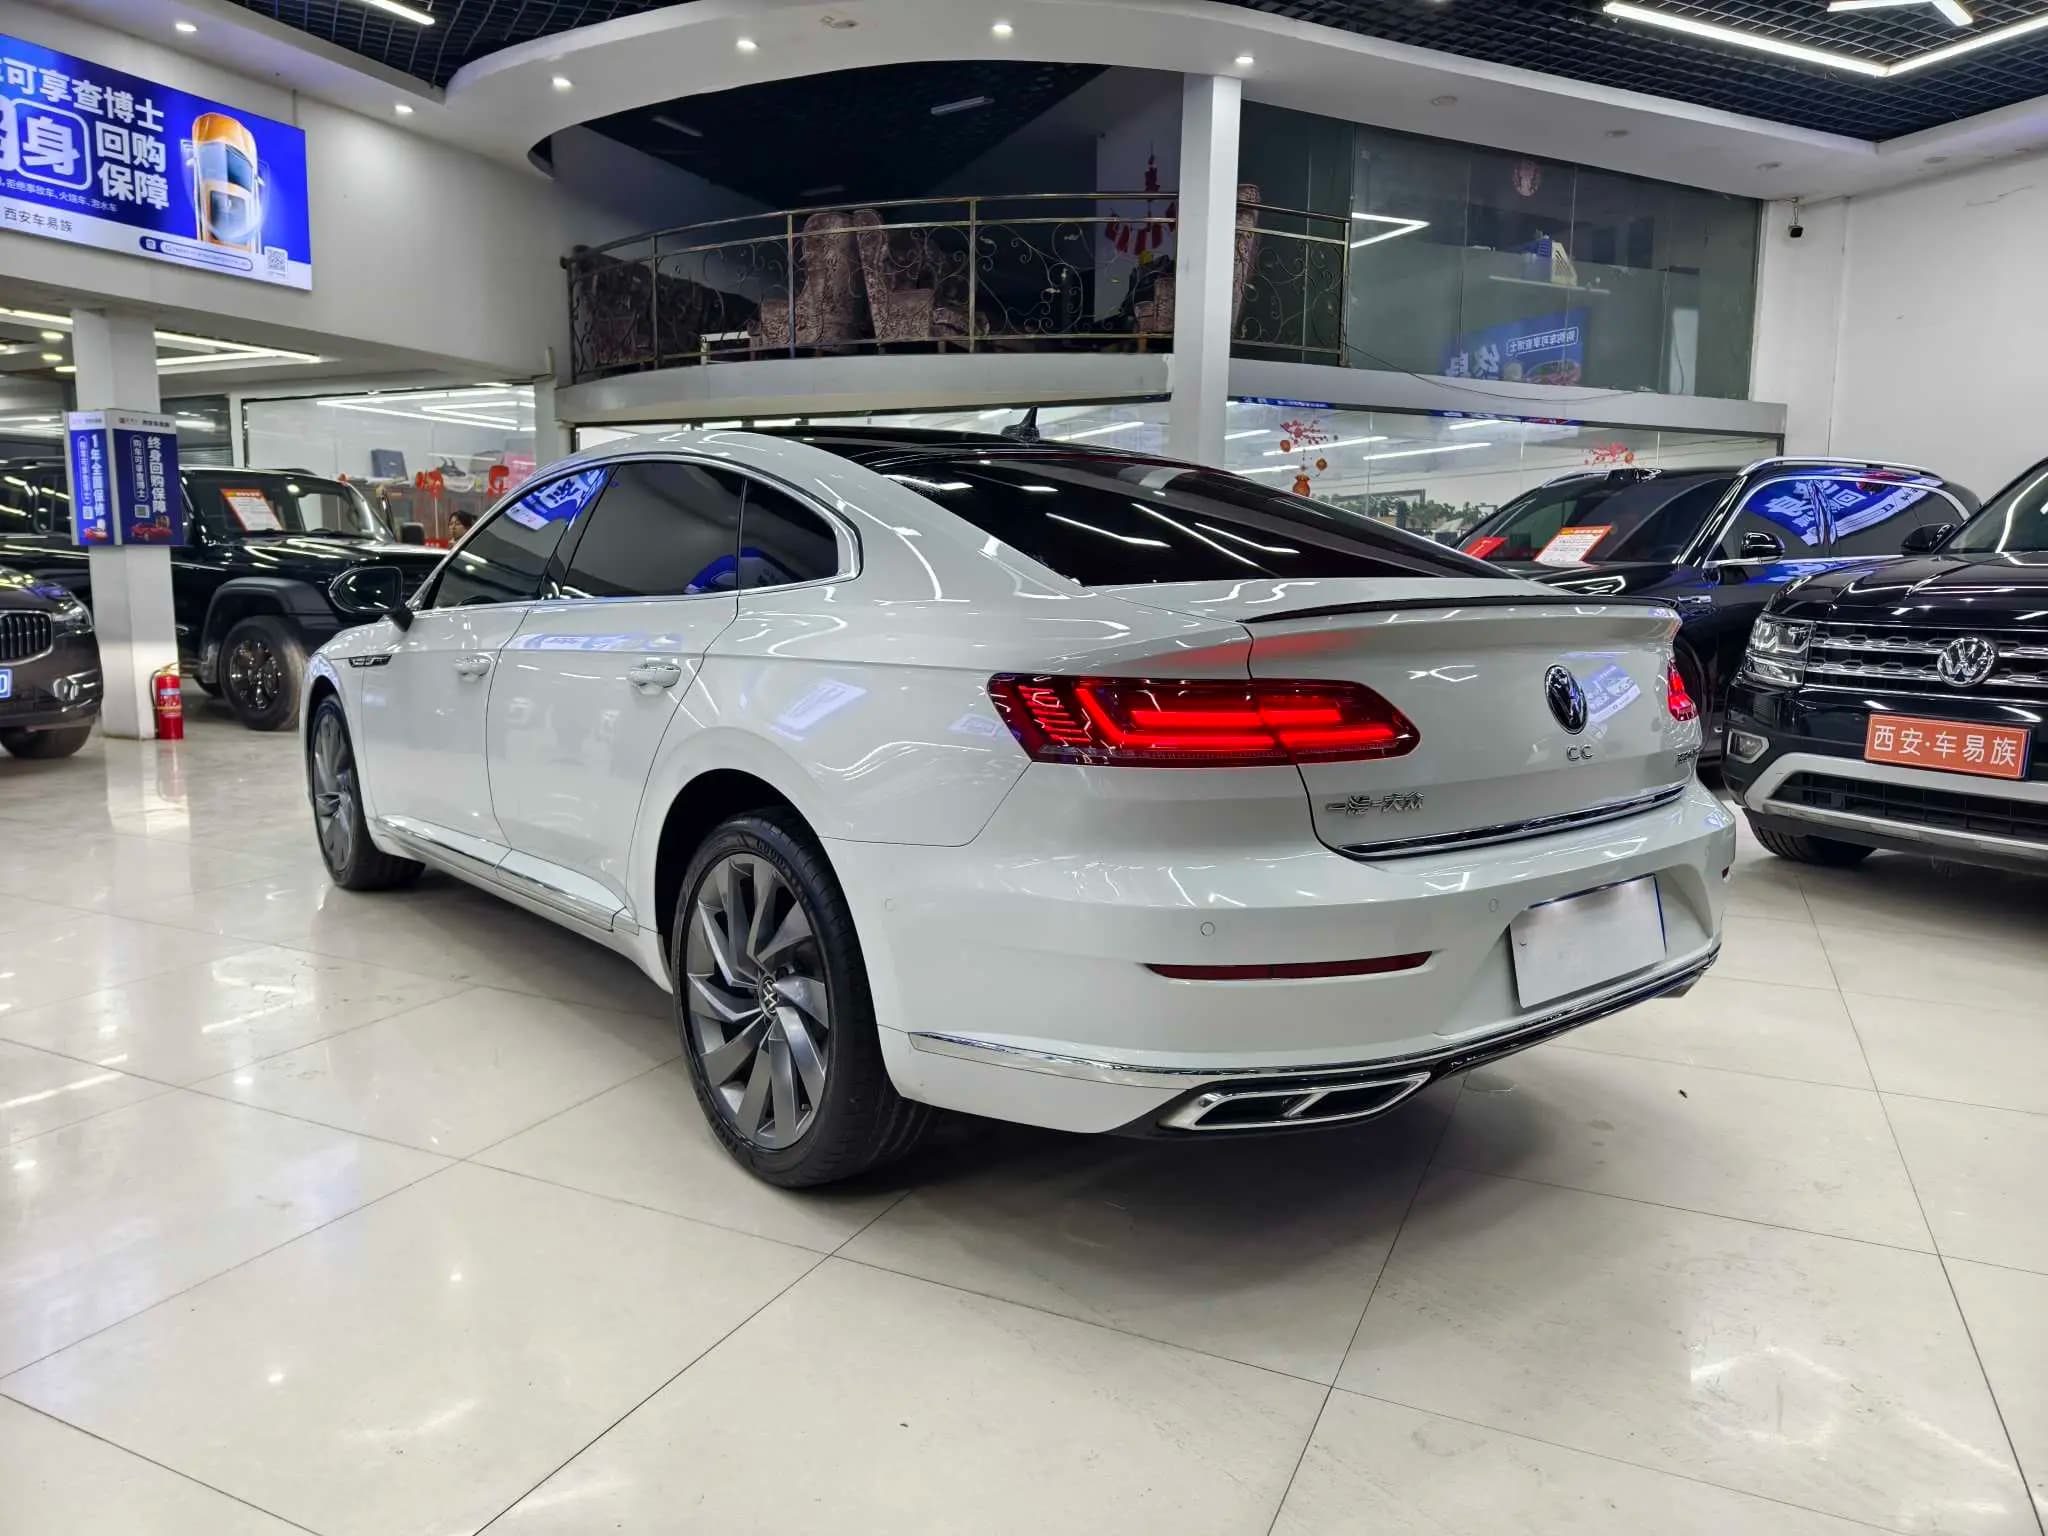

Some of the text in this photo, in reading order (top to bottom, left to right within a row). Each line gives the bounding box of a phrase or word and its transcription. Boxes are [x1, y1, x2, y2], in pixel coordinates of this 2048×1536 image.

[95, 120, 166, 173] 回购
[97, 161, 169, 210] 保障
[4, 206, 73, 233] 西安车易族
[147, 436, 167, 514] 终身回购保障
[1566, 744, 1594, 762] CC
